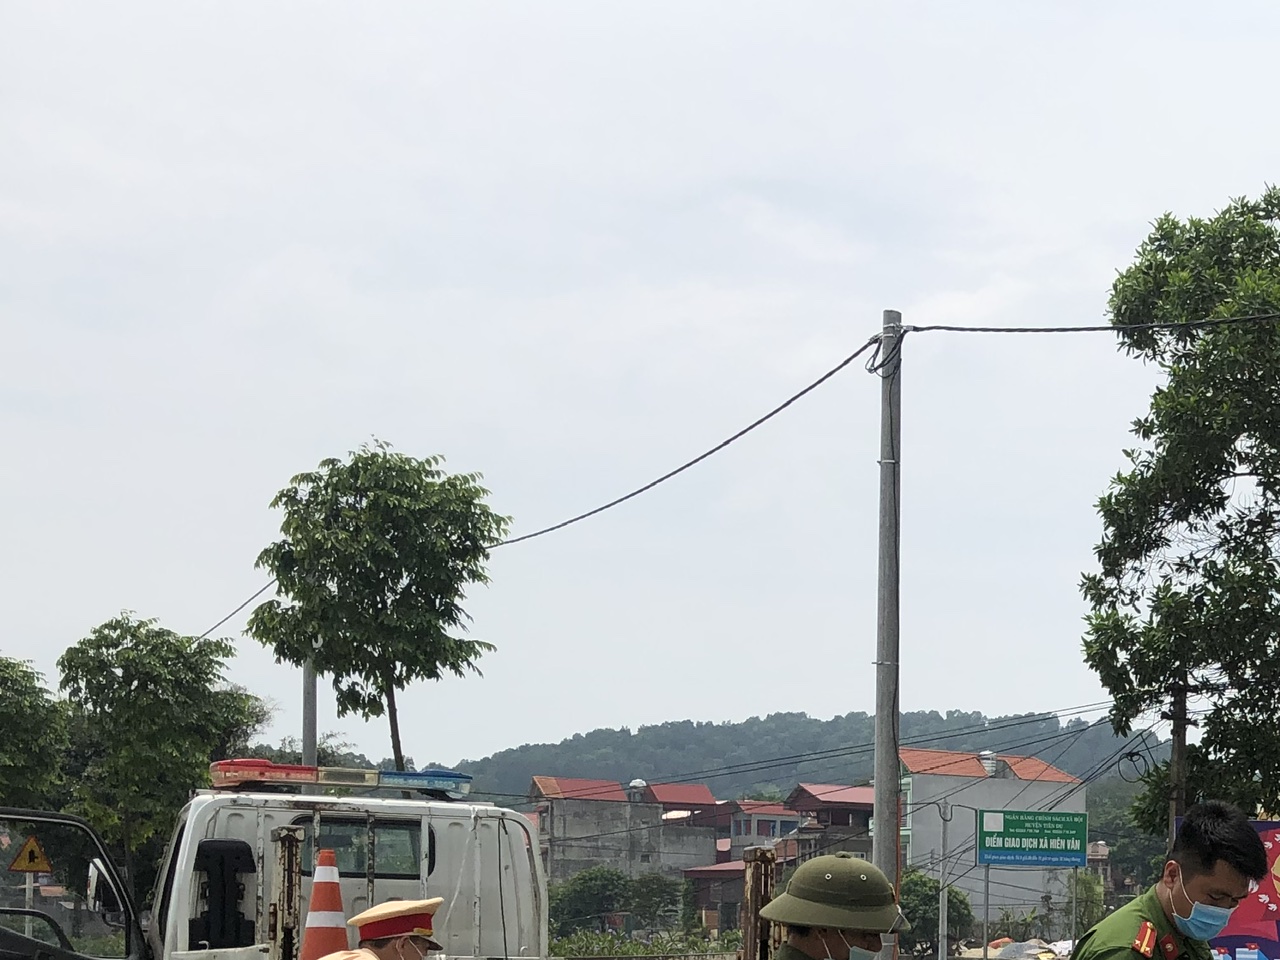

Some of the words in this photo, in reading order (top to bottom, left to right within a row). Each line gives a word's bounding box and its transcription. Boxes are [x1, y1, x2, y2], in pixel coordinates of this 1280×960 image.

[1005, 838, 1020, 847] GIAO
[1022, 838, 1037, 851] DỊCH
[1039, 837, 1048, 848] XÃ
[1050, 837, 1065, 849] HIÊN
[1066, 837, 1080, 850] VÂN
